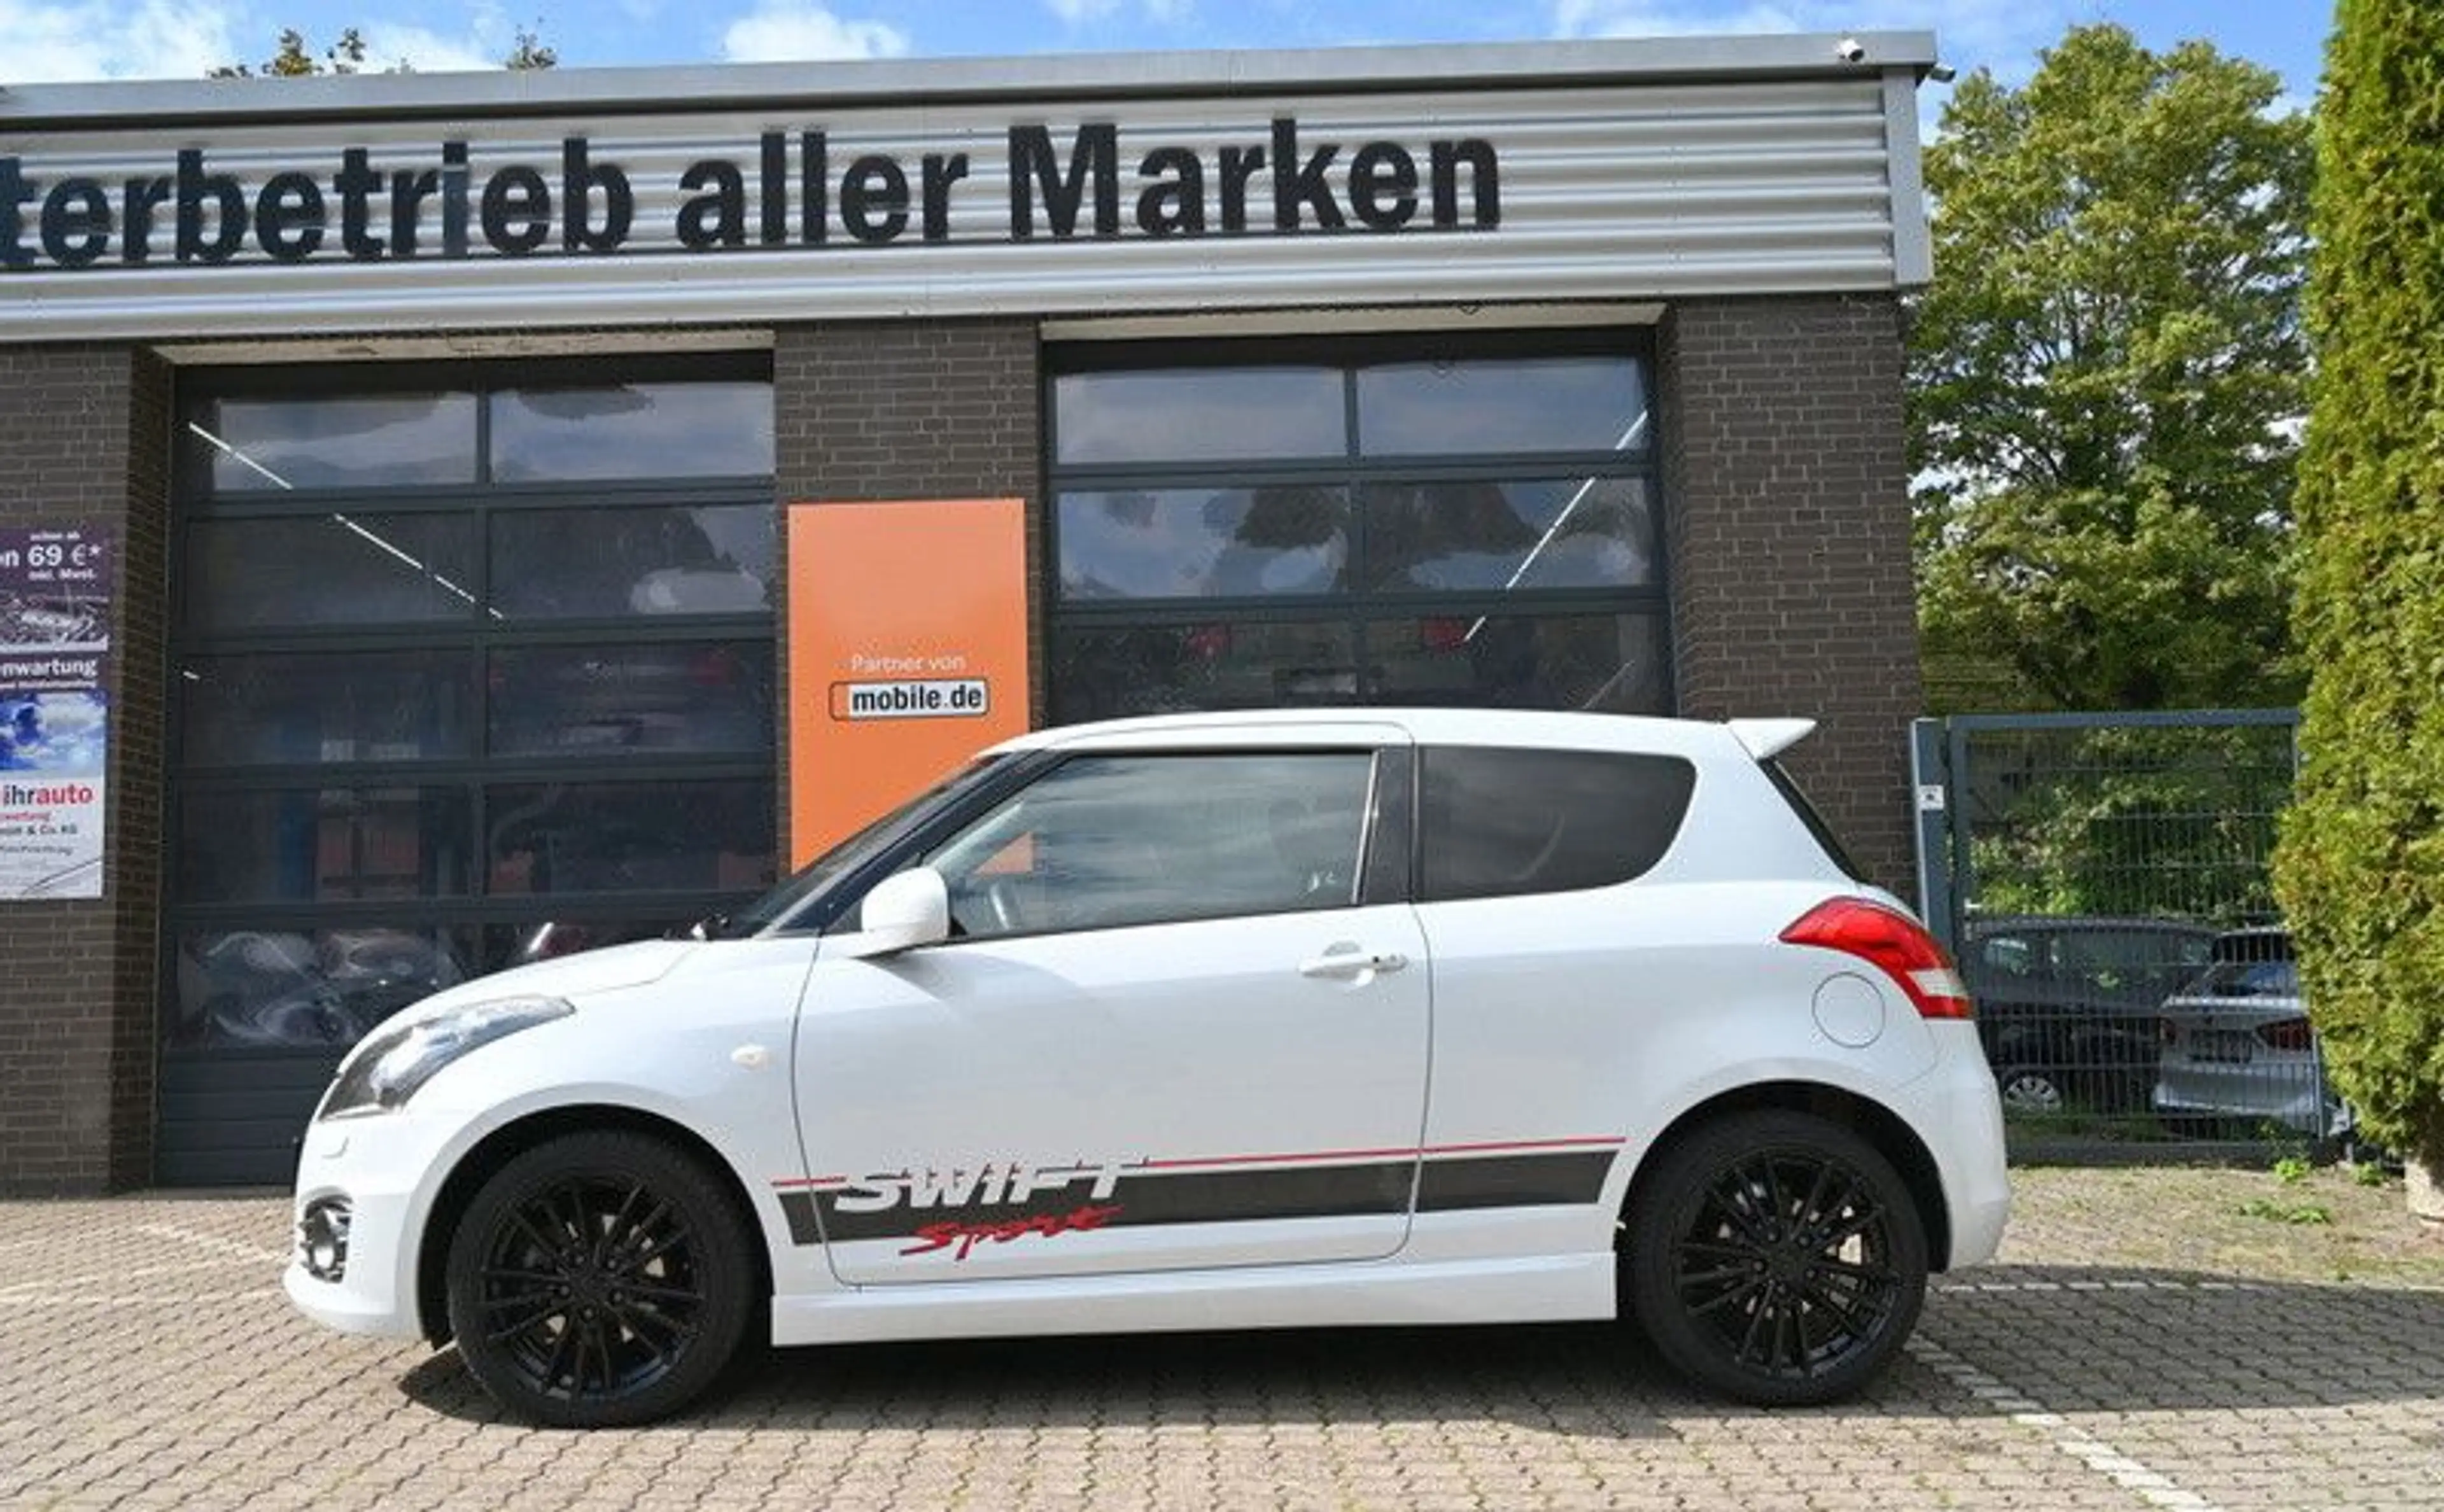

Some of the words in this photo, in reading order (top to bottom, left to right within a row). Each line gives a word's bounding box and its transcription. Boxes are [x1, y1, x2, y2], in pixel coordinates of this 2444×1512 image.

[675, 130, 969, 251] aller
[1008, 118, 1501, 237] Marken
[27, 544, 62, 566] 69
[851, 654, 923, 672] Partner
[928, 655, 967, 671] von
[852, 684, 982, 711] mobile.de
[3, 784, 93, 805] ihrauto
[834, 1158, 1148, 1212] SWIFT
[899, 1205, 1125, 1261] Sport
